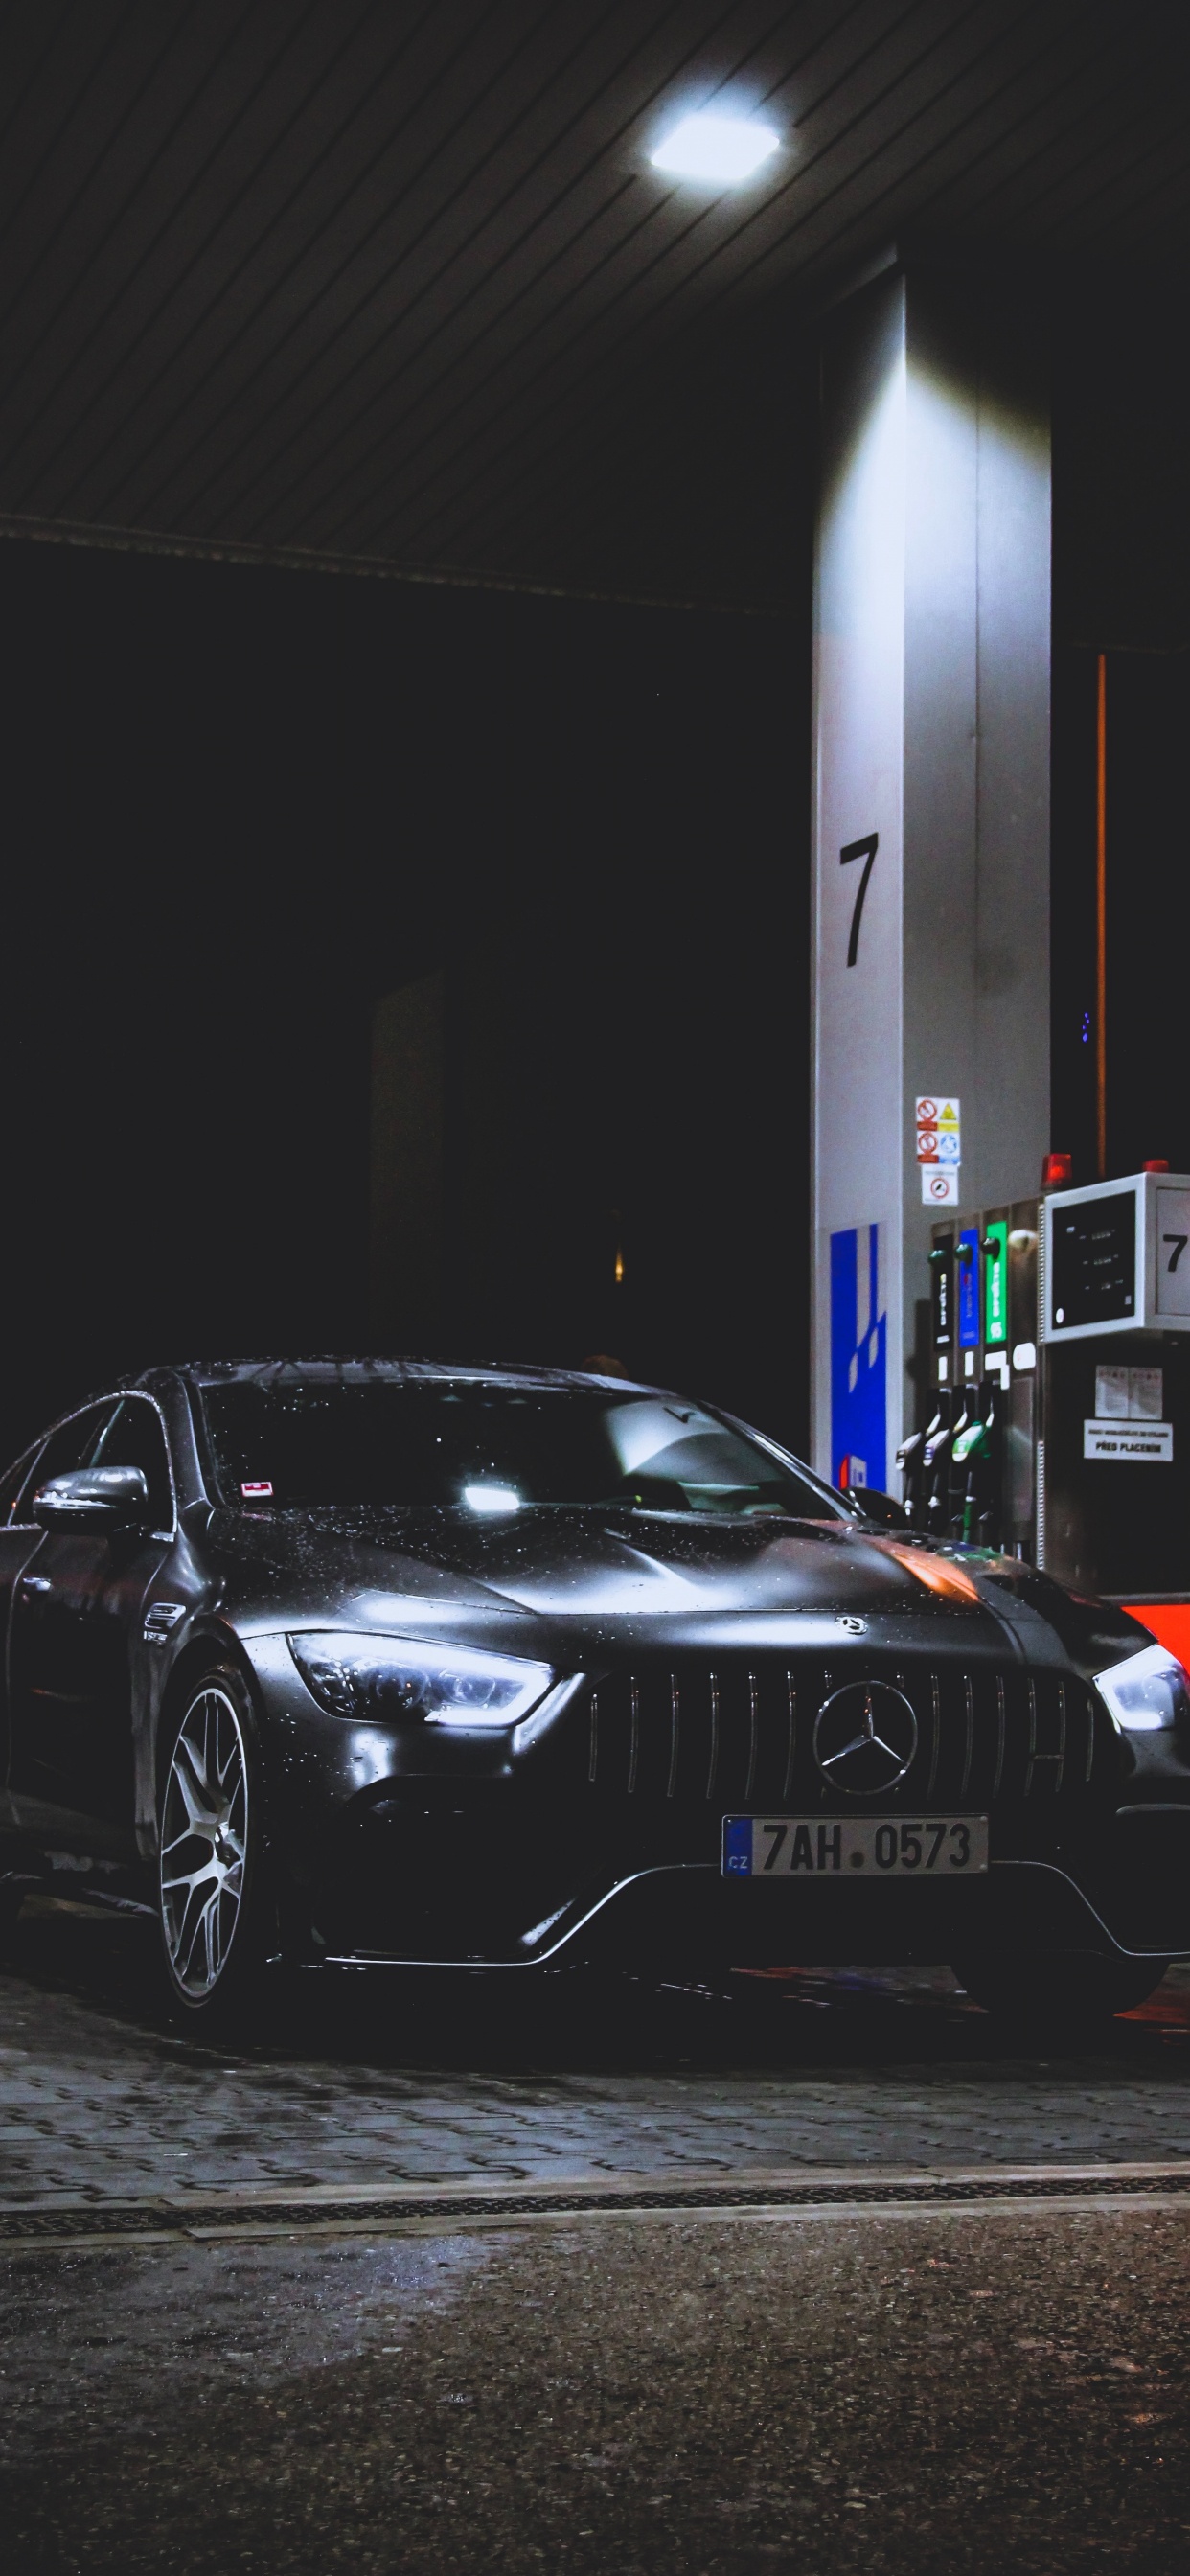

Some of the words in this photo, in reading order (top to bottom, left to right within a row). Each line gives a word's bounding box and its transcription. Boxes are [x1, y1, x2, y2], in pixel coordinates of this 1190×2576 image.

[839, 831, 879, 968] 7
[1163, 1234, 1188, 1273] 7
[728, 1856, 748, 1869] CZ
